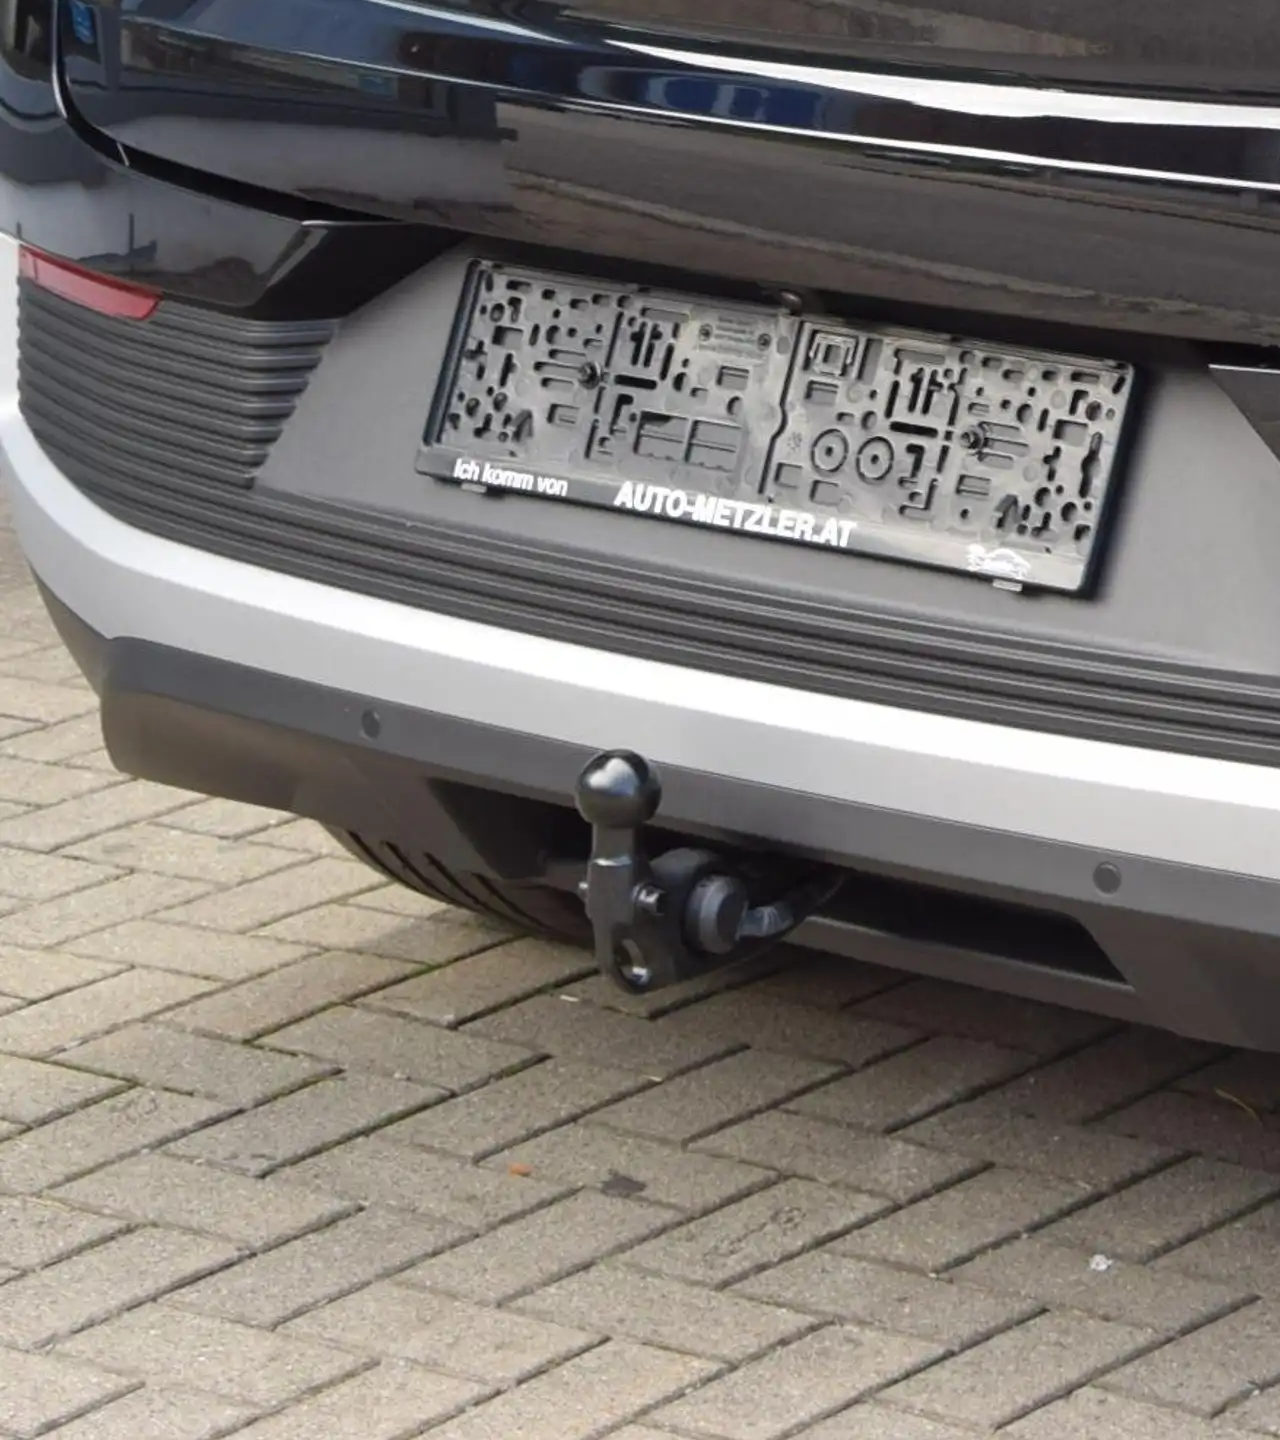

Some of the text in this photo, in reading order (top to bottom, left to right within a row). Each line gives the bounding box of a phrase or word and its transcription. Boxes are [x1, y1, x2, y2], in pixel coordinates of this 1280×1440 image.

[482, 463, 534, 492] komm
[537, 476, 569, 497] von
[613, 481, 857, 548] AUTO-METZLER.AT
